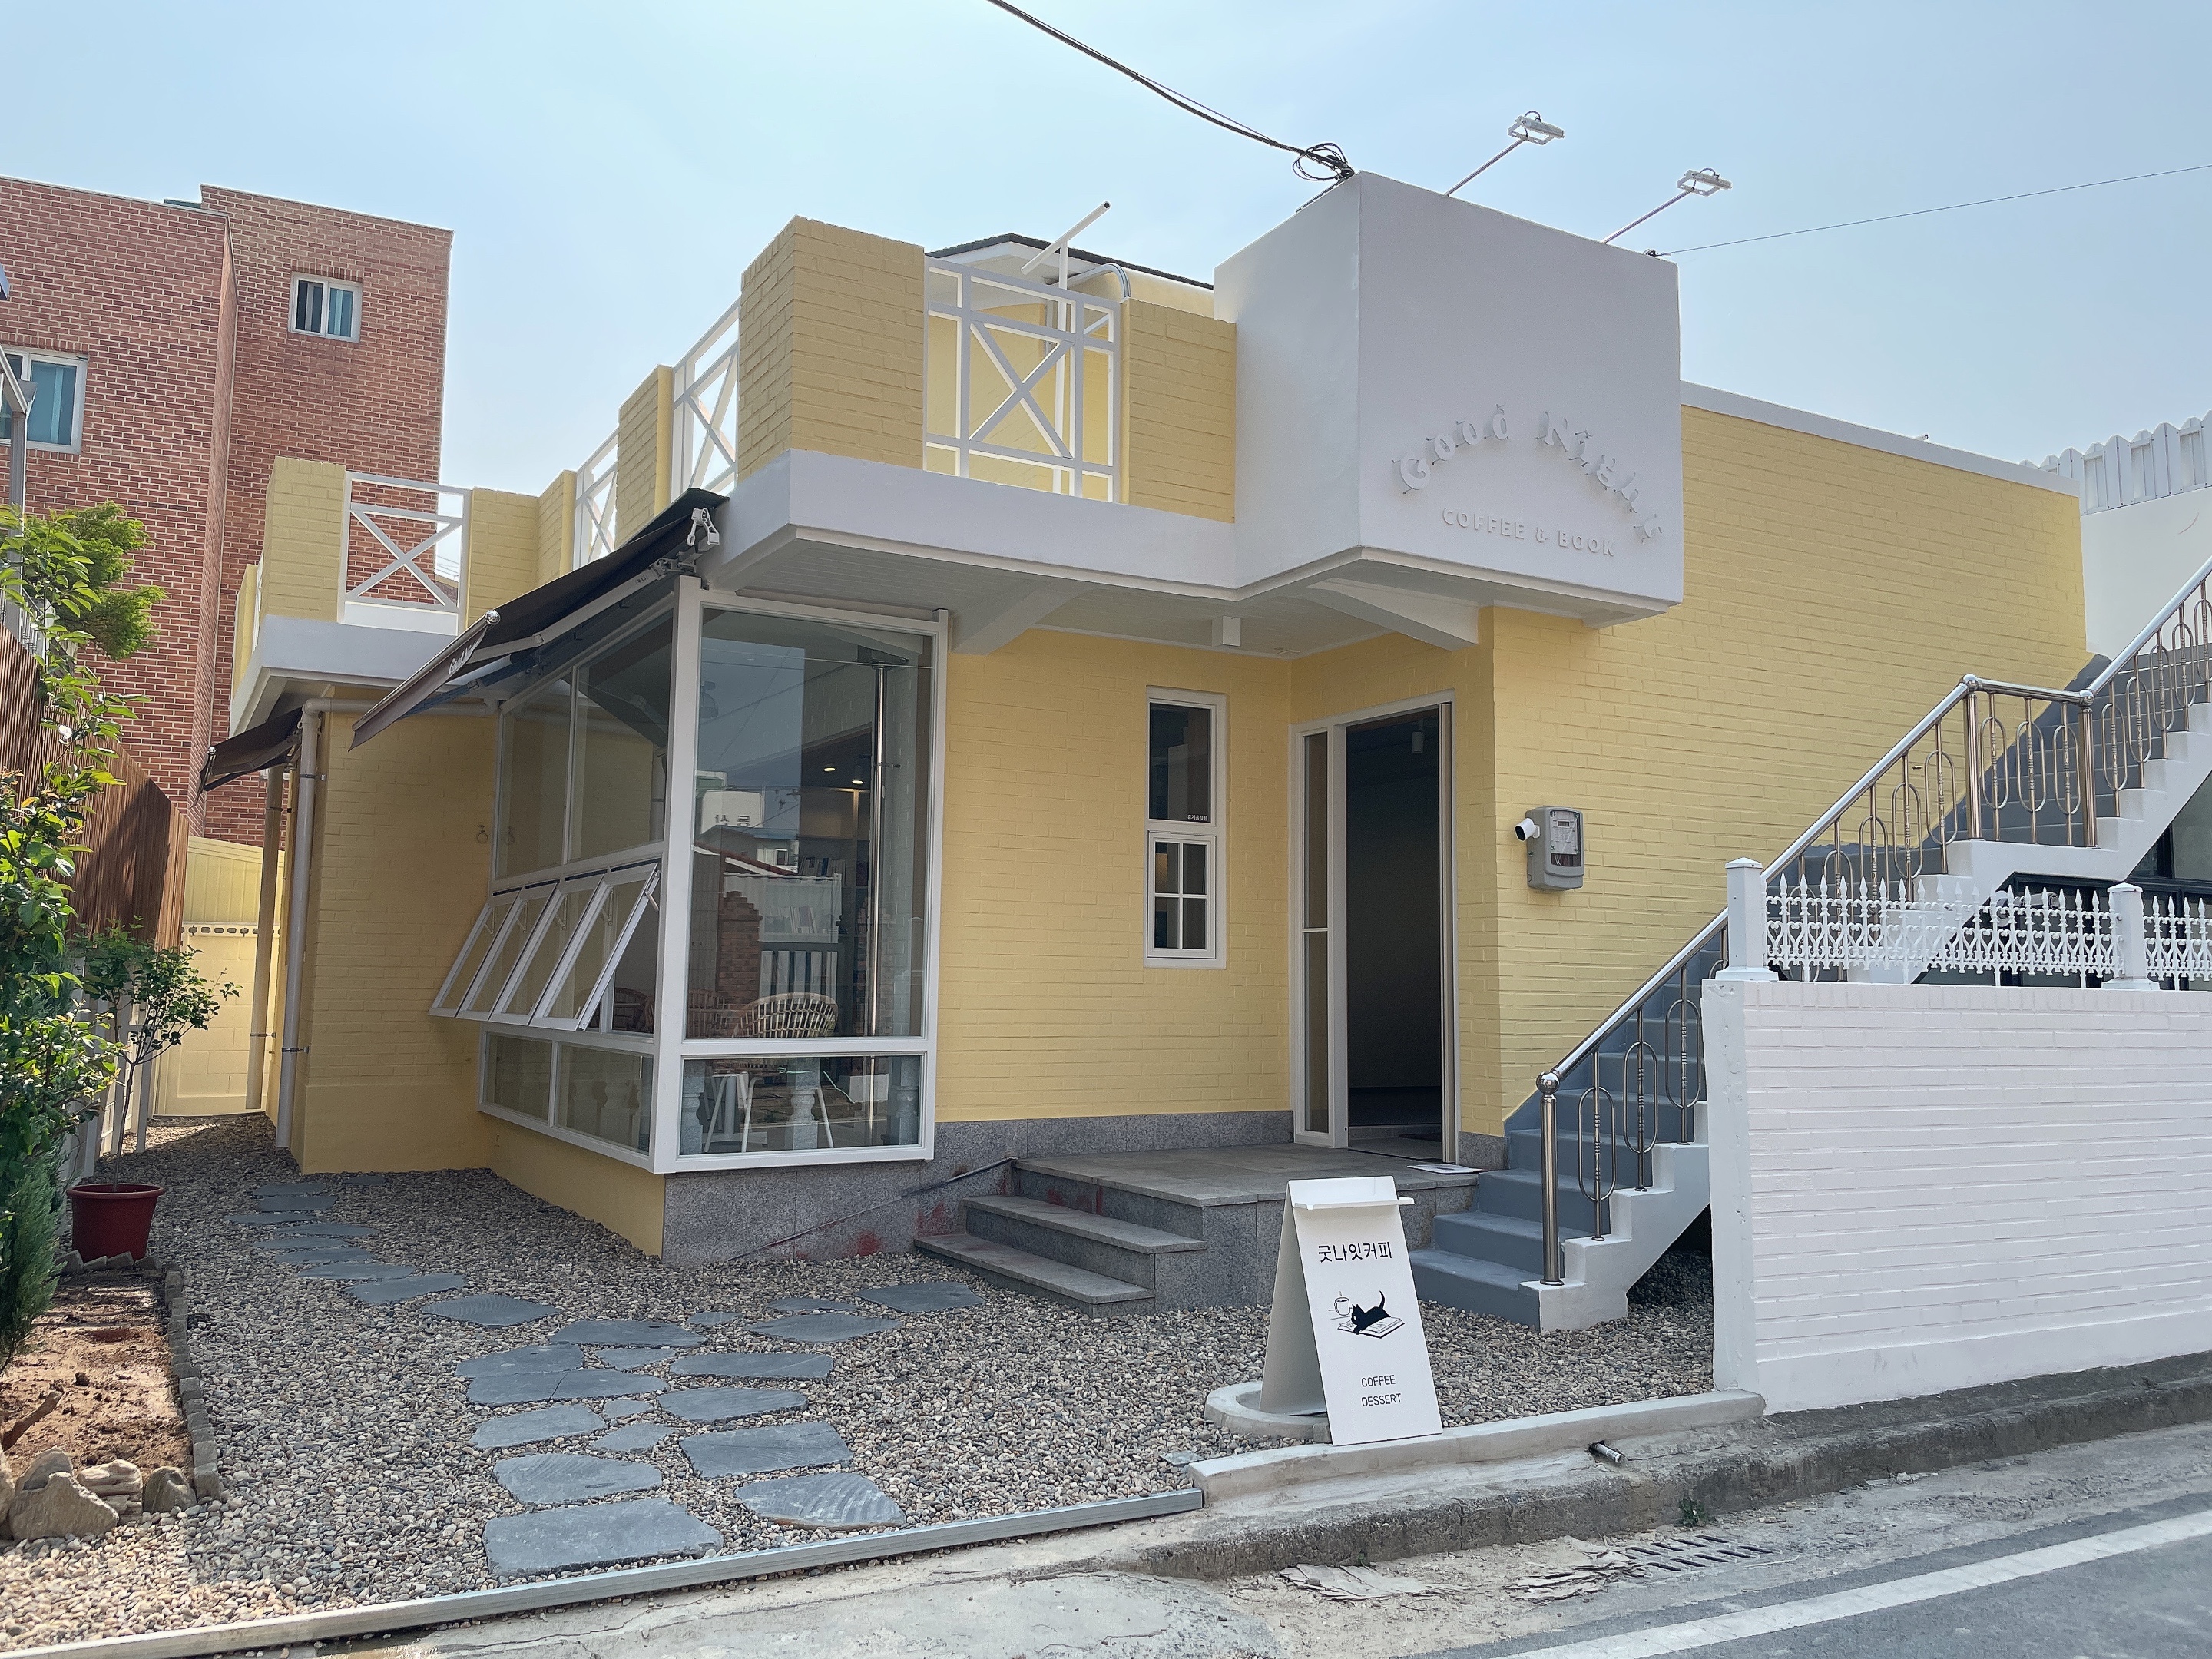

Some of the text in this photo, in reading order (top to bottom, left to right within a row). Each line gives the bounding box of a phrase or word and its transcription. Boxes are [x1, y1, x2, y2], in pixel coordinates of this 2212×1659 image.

[1442, 508, 1614, 557] COFFEE & BOOK
[1318, 1241, 1392, 1263] 굿나잇커피
[1361, 1374, 1396, 1388] COFFEE
[1361, 1392, 1402, 1407] DESSERT
